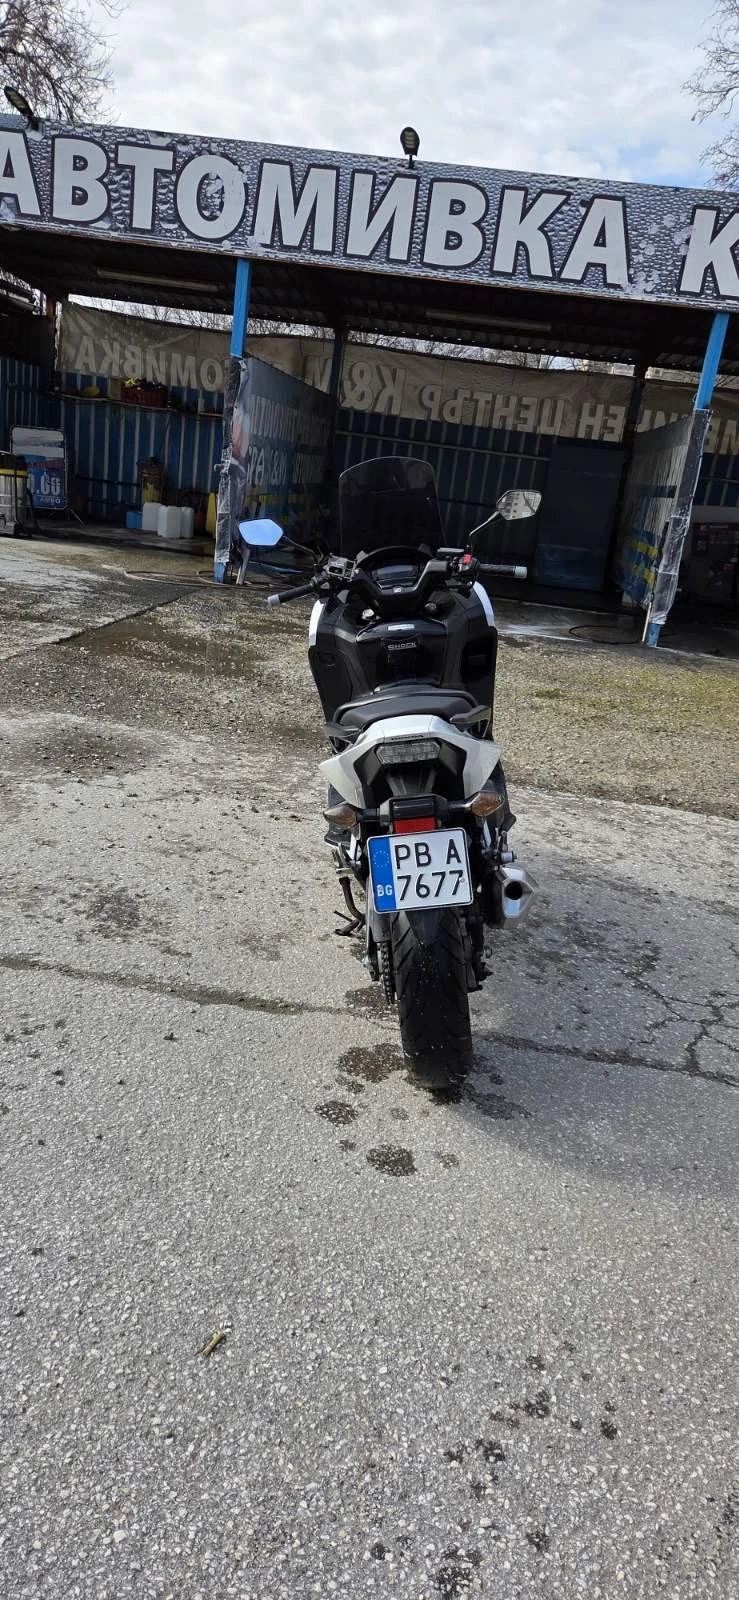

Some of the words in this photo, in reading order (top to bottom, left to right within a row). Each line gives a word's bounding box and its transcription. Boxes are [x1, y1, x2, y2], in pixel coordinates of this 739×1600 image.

[0, 129, 632, 288] АВТОМИВКА
[394, 842, 432, 869] PB
[446, 838, 461, 864] A
[376, 884, 393, 896] BG
[397, 869, 463, 900] 7677
